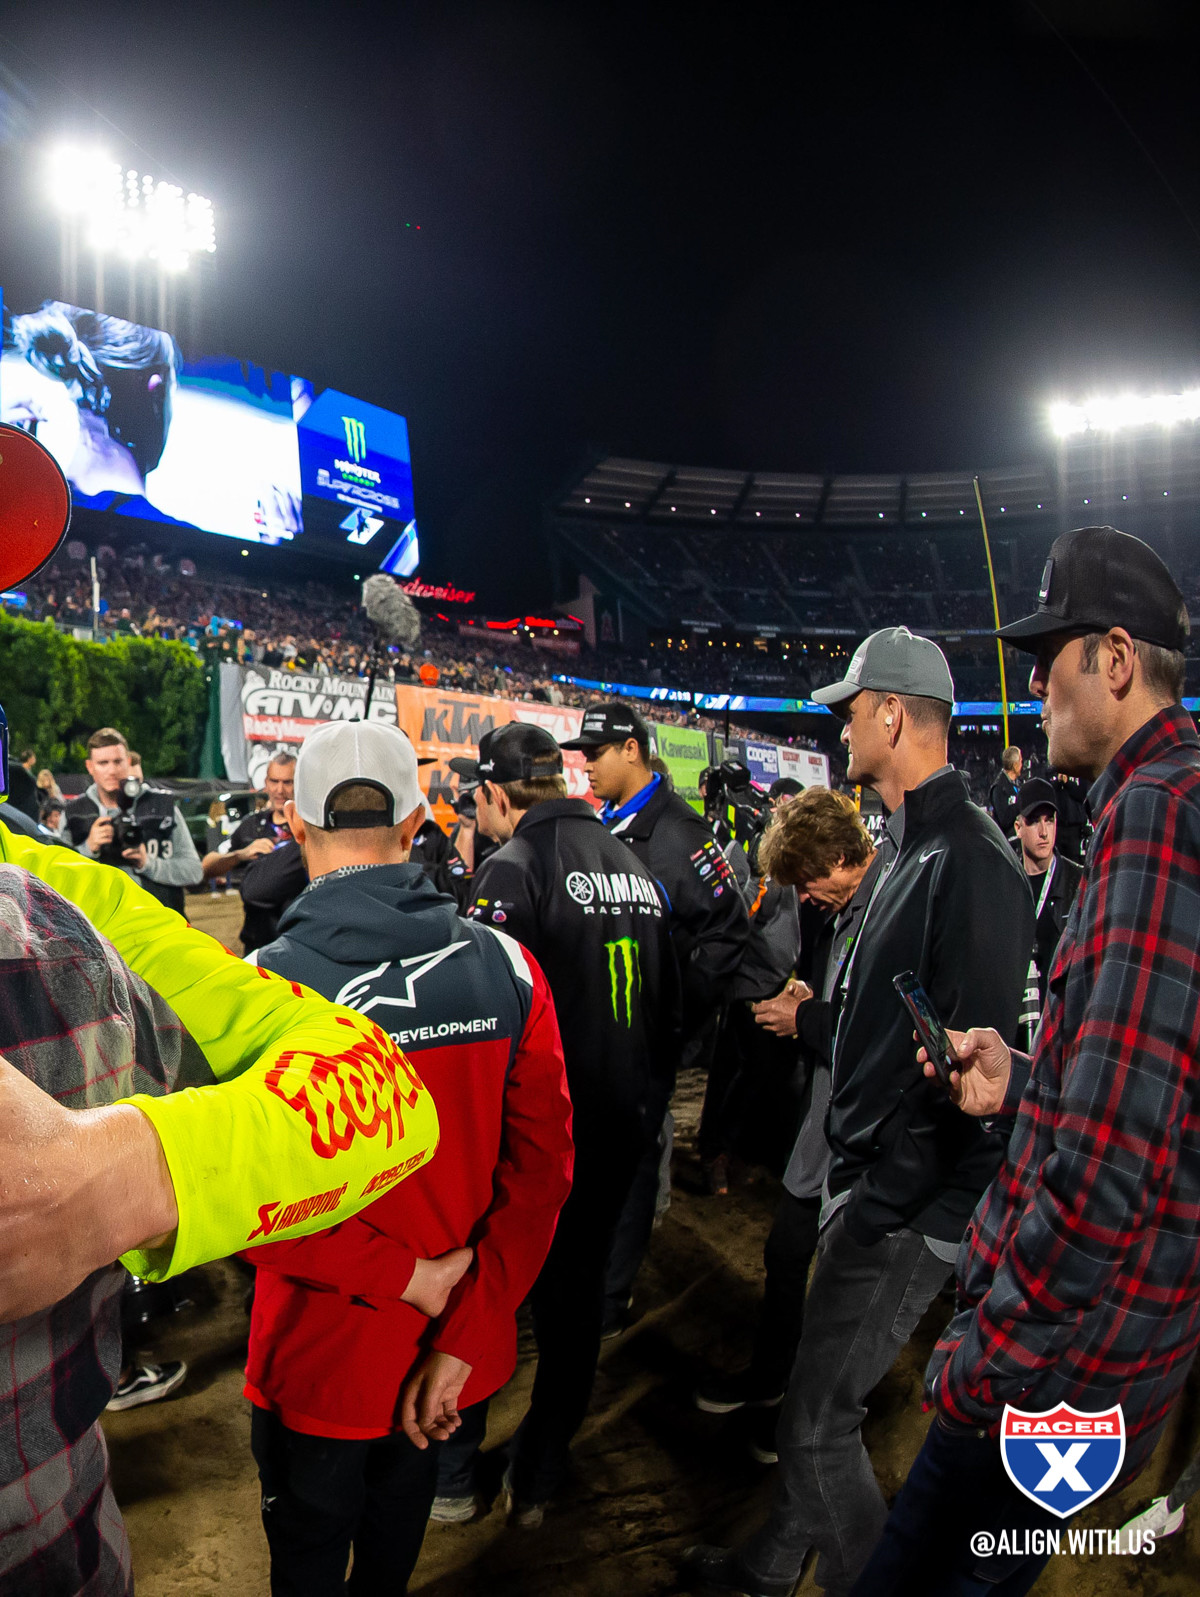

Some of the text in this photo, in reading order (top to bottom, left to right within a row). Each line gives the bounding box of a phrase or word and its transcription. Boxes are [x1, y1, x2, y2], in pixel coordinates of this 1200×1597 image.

[268, 669, 395, 702] ROCKY MOUNAIN
[421, 699, 495, 746] KTM
[660, 737, 706, 761] Kawasaki
[747, 746, 777, 763] COOPER
[589, 871, 662, 910] YAMAHA
[583, 905, 662, 918] RACING
